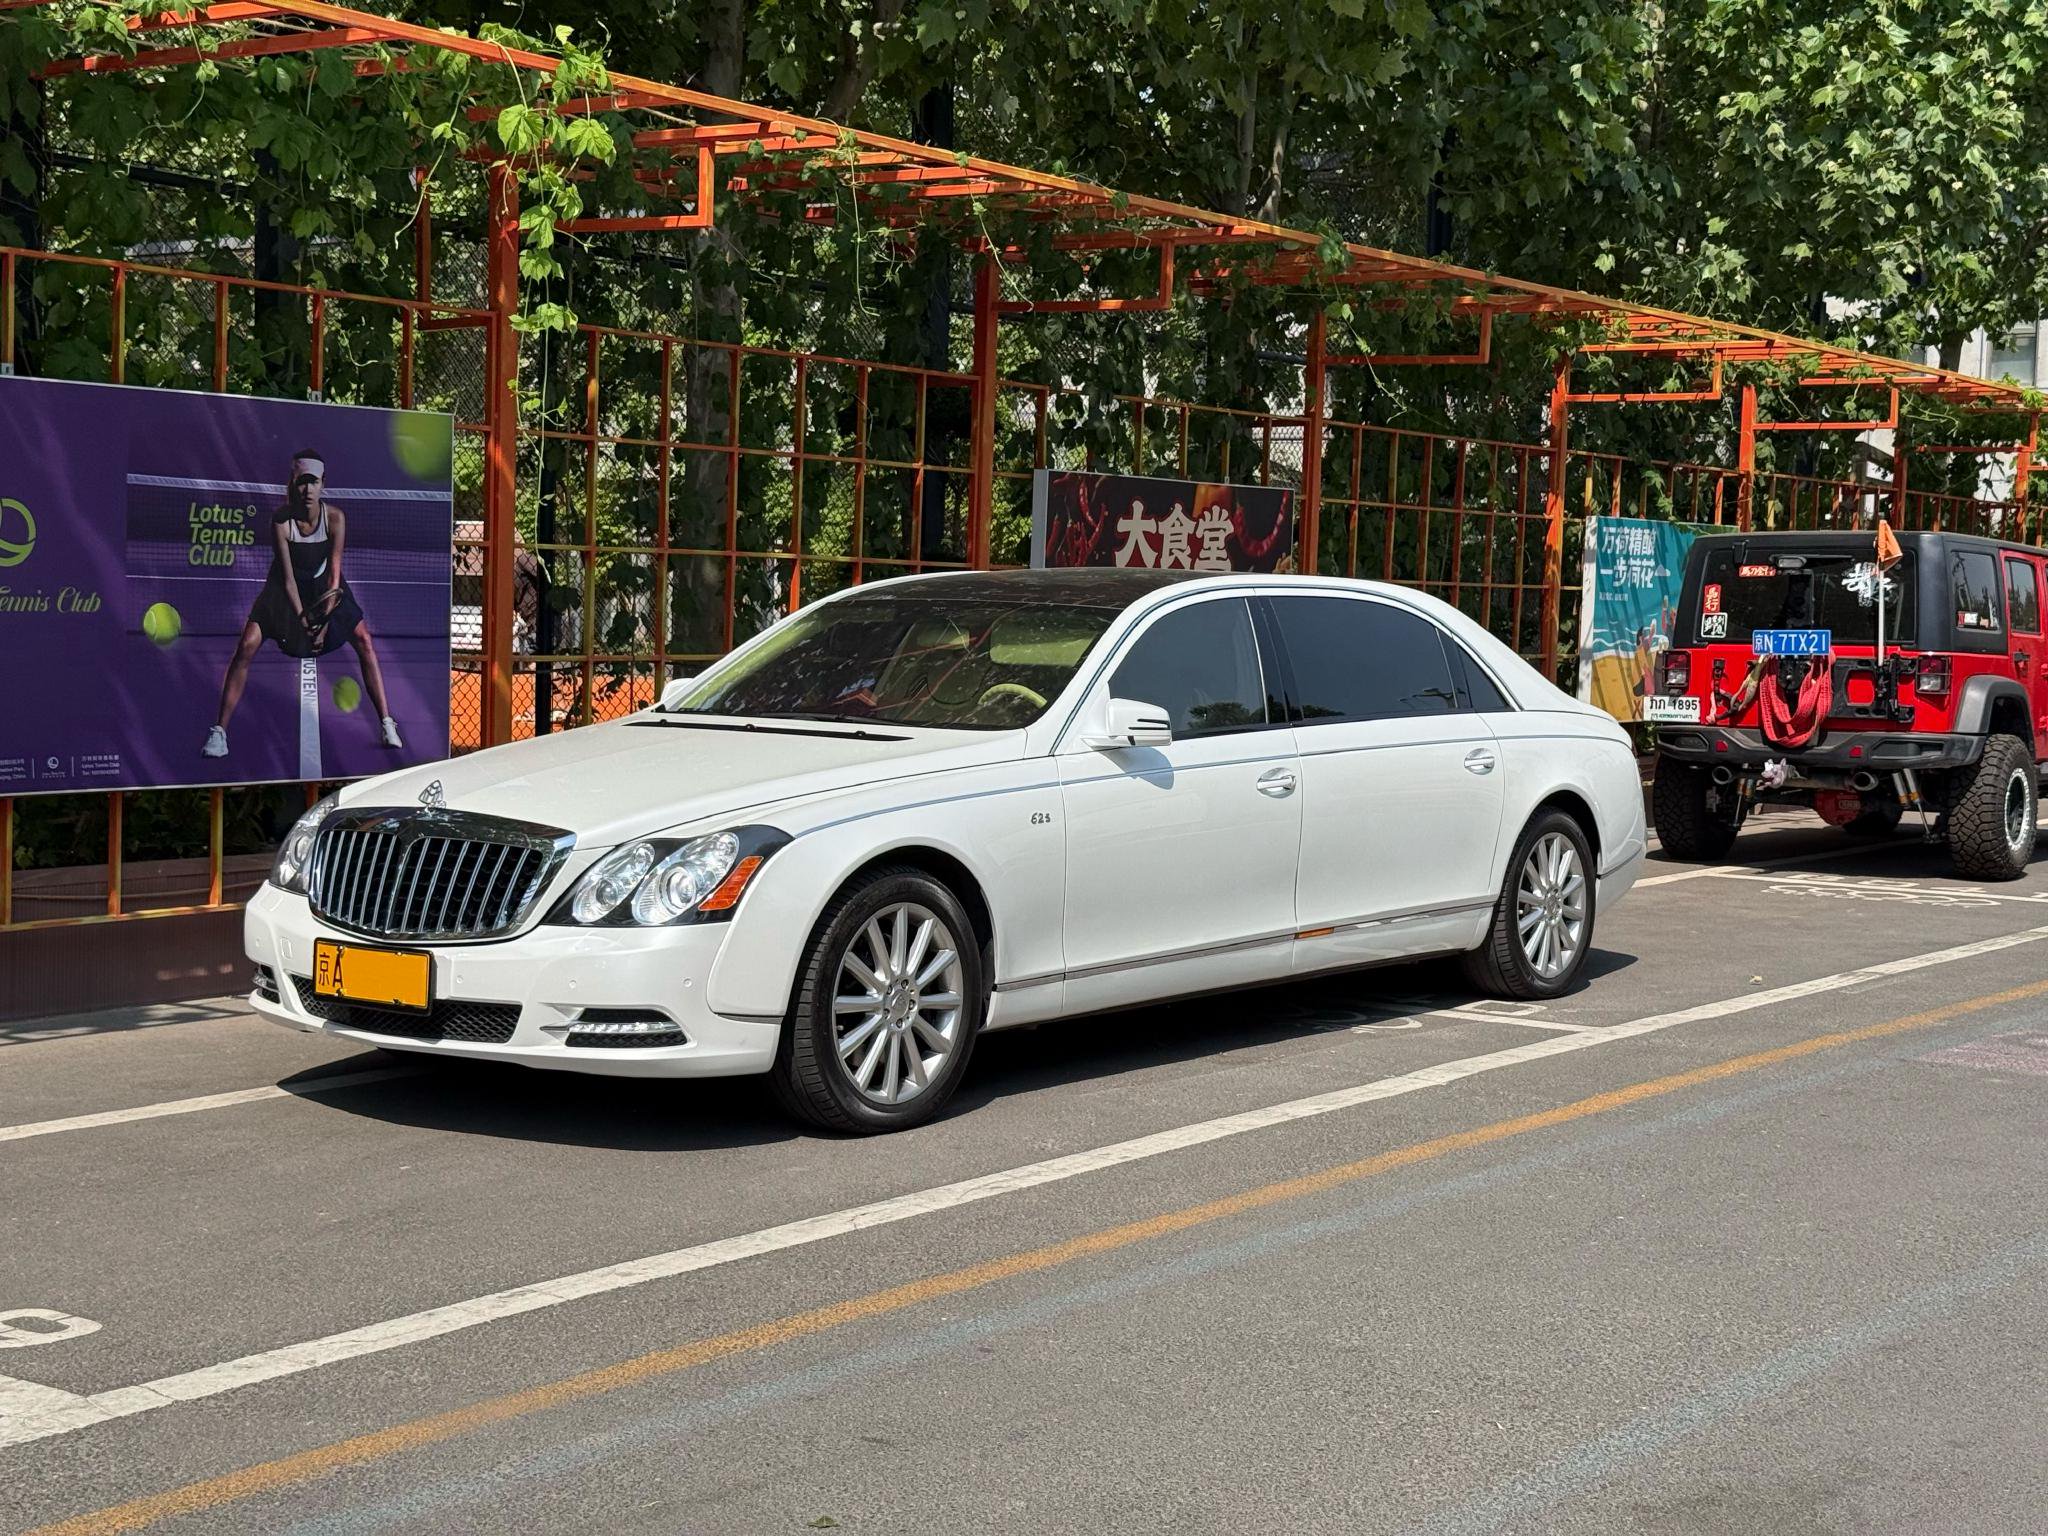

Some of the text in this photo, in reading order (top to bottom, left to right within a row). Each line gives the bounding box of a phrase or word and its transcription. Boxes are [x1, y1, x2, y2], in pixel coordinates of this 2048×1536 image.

[188, 502, 244, 523] Lotus
[190, 523, 255, 546] Tennis
[1114, 500, 1235, 571] 大食堂
[1601, 526, 1657, 556] 万荷精酿
[188, 545, 235, 566] Club
[57, 585, 101, 613] Club
[1672, 699, 1698, 711] 1895
[319, 951, 344, 988] 京A
